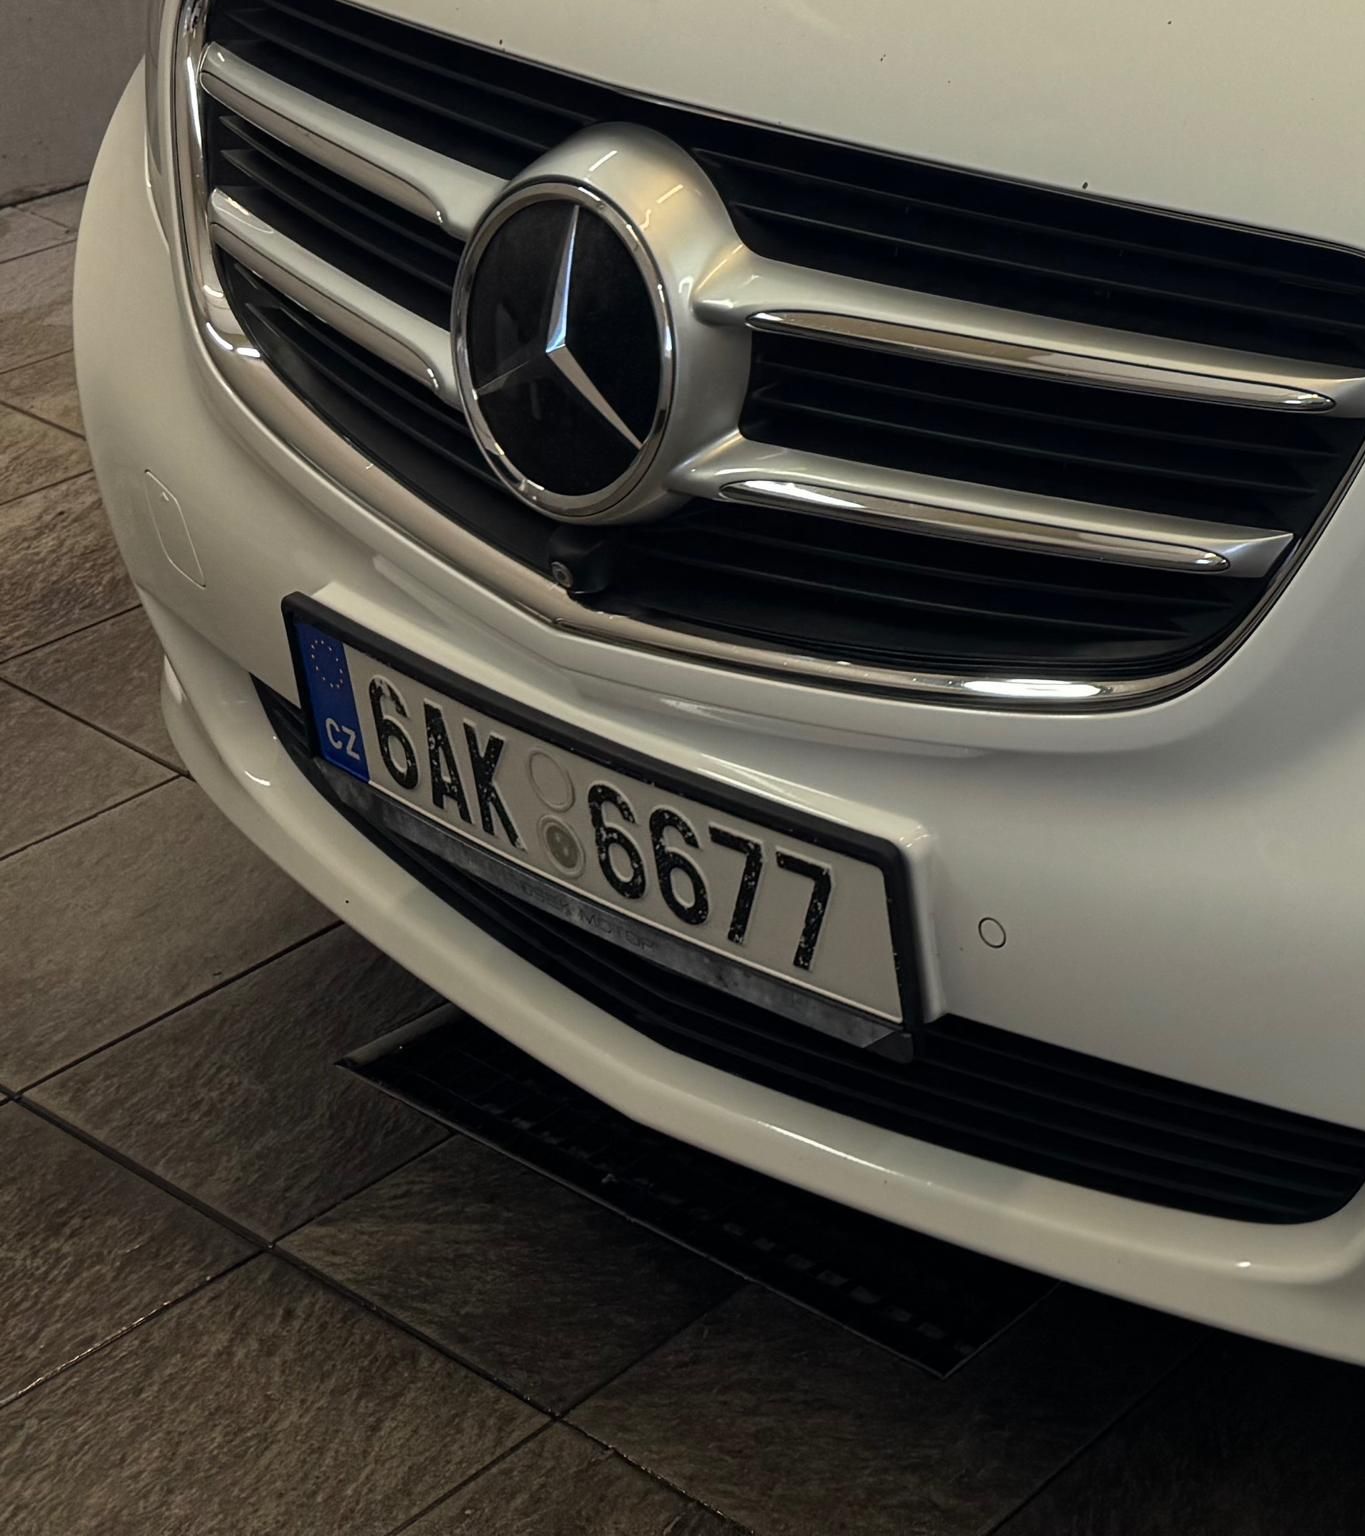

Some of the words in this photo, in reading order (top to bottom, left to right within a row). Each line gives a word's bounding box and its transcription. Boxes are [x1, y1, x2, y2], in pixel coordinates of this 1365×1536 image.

[325, 715, 360, 761] CZ
[368, 676, 526, 851] 6AK
[587, 782, 833, 971] 6677
